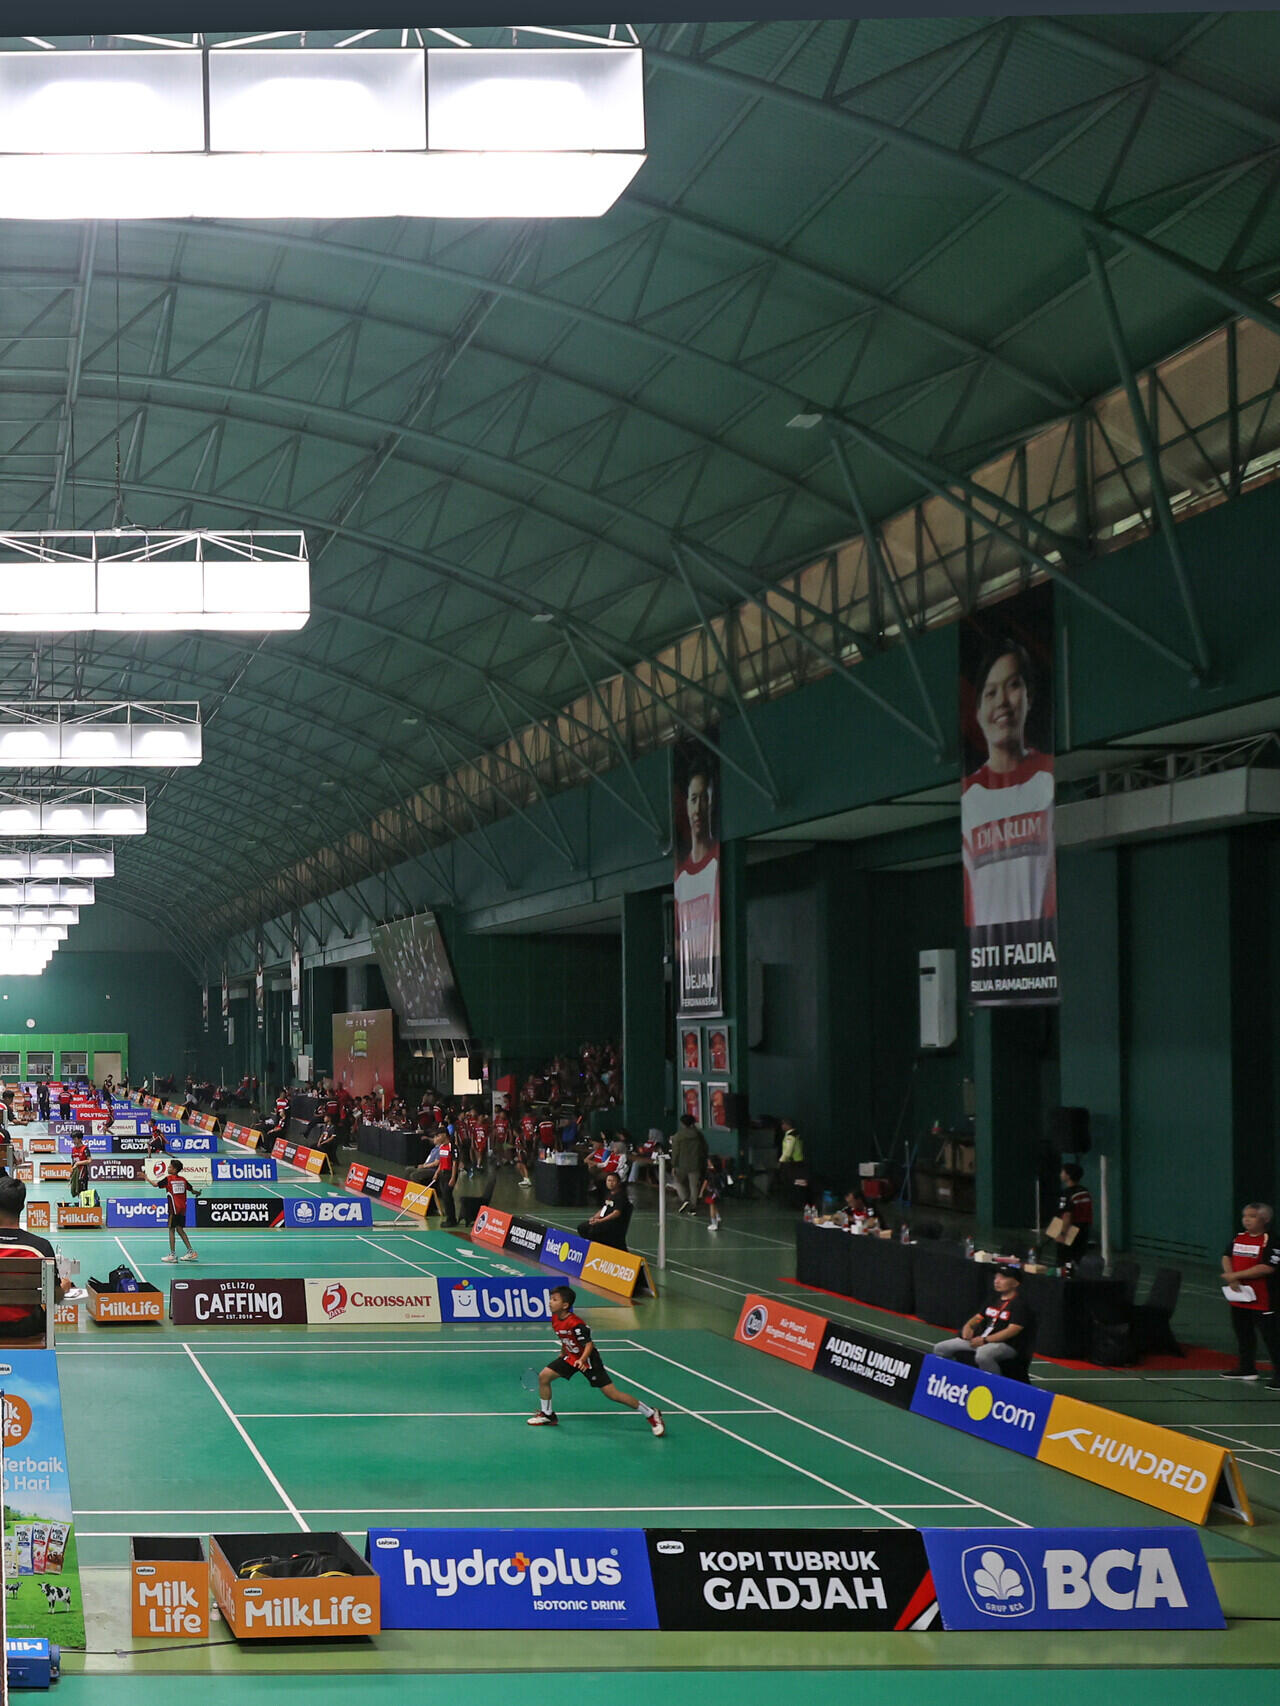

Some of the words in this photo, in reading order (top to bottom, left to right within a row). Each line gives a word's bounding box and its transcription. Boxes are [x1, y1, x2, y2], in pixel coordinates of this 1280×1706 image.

[971, 945, 1000, 968] SITI
[1004, 941, 1056, 966] FADIA
[184, 1140, 210, 1150] BCA
[90, 1165, 134, 1179] CAFFINO
[231, 1164, 271, 1179] blibli
[28, 1209, 47, 1218] Milk
[60, 1213, 100, 1224] MilkLife
[116, 1203, 169, 1218] hydropl
[211, 1211, 269, 1222] GADJAH
[318, 1203, 363, 1221] BCA
[31, 1217, 48, 1227] Life
[598, 1259, 635, 1282] HUNDRED
[220, 1281, 255, 1292] DELIZIO
[195, 1292, 282, 1321] CAFFINO
[327, 1283, 346, 1312] 5
[351, 1293, 432, 1308] CROISSANT
[482, 1287, 552, 1319] blibl
[100, 1302, 160, 1316] MilkLife
[328, 1309, 346, 1320] DAYS
[825, 1335, 866, 1363] AUDISI
[869, 1352, 912, 1380] UMUM
[830, 1354, 841, 1366] PB
[841, 1357, 875, 1380] DJARUM
[873, 1369, 897, 1388] 2025
[1088, 1433, 1208, 1495] HUNDRED
[14, 1474, 51, 1491] Hari
[699, 1551, 764, 1571] KOPI
[768, 1551, 880, 1571] TUBRUK
[403, 1548, 623, 1597] hydroplus
[1042, 1547, 1189, 1612] BCA
[139, 1581, 199, 1608] Milk
[703, 1577, 888, 1611] GADJAH
[245, 1596, 372, 1628] MilkLife
[533, 1600, 589, 1611] ISOTONIC
[591, 1600, 627, 1611] DRINK
[984, 1602, 1008, 1614] GRUP
[1010, 1602, 1025, 1613] BCA
[149, 1607, 203, 1634] Life
